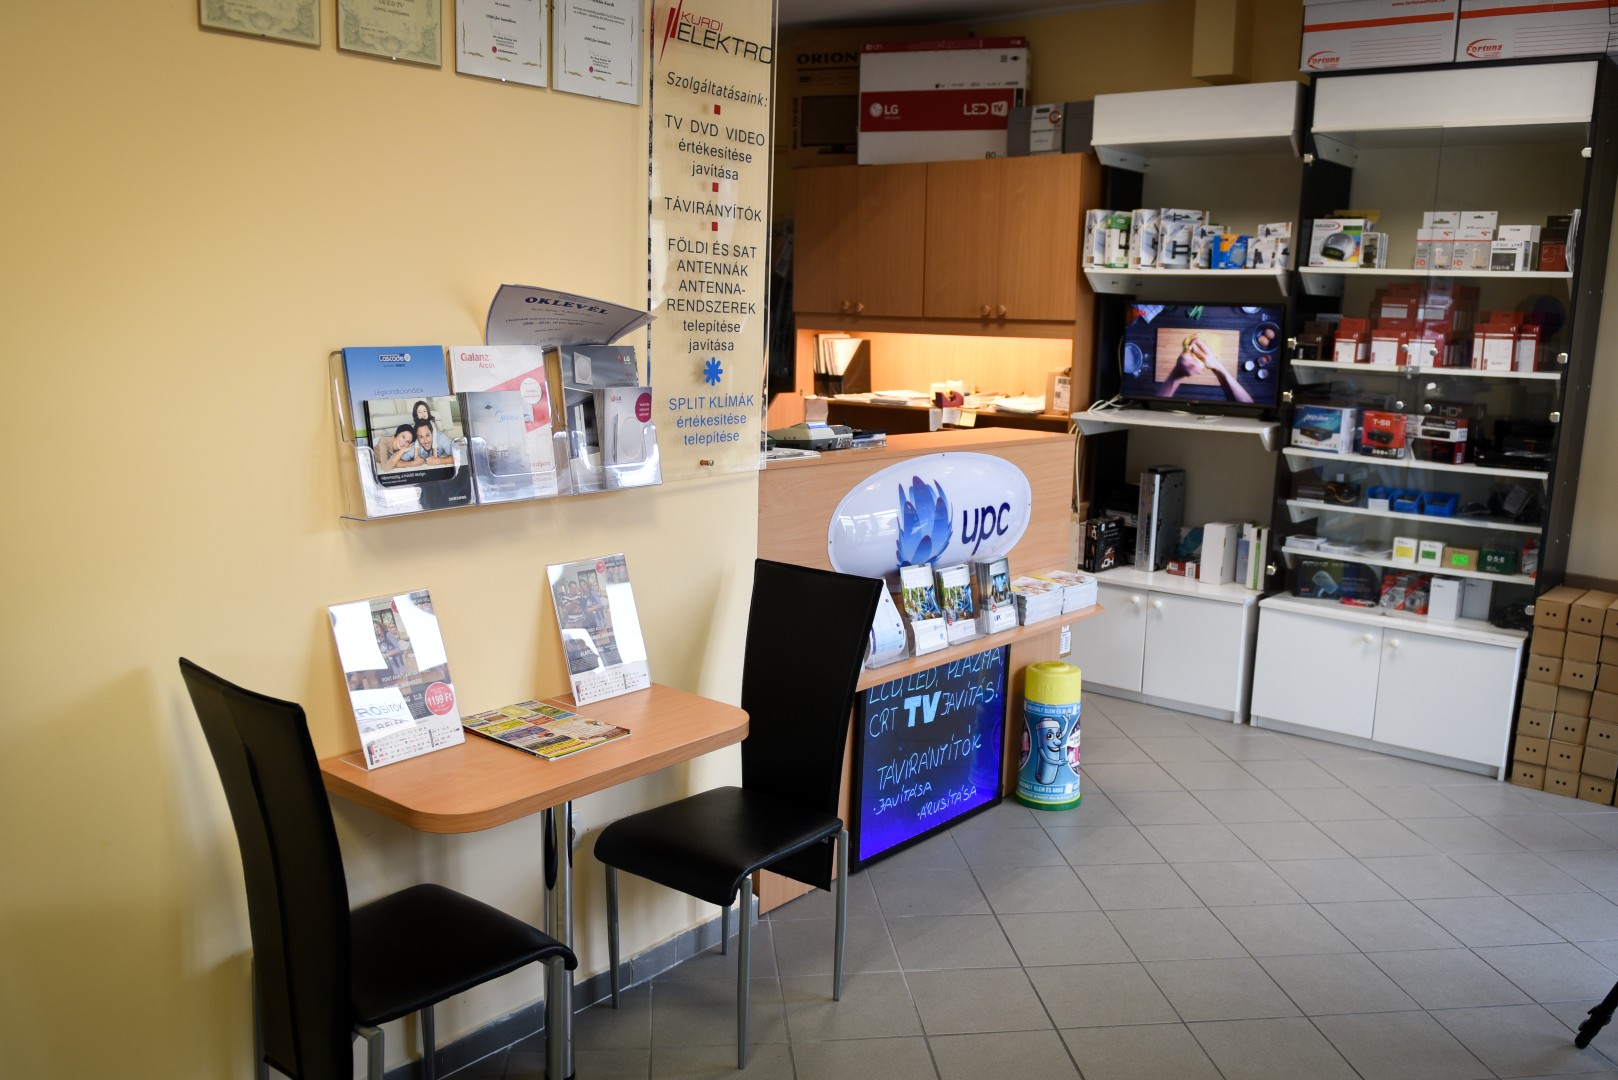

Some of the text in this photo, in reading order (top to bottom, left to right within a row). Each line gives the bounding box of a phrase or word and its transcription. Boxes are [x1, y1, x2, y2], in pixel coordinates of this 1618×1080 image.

[680, 10, 723, 32] KURDI
[677, 22, 773, 64] ELEKTRO
[796, 52, 857, 66] ORION
[666, 71, 768, 108] Szolgáltatásaink:
[884, 104, 899, 115] LG
[963, 103, 989, 116] LED
[665, 114, 765, 147] TV DVD VIDEO
[678, 138, 752, 163] értékesítése
[692, 161, 739, 180] javítása
[665, 196, 762, 222] TÁVIRÁNYÍTÓK
[668, 237, 757, 259] FÖLDI ÉS SAT
[677, 259, 748, 277] ANTENNÁK
[678, 279, 746, 295] ANTENNA-
[524, 296, 609, 315] OKLEVÉL
[667, 298, 756, 315] RENDSZEREK
[683, 319, 741, 334] telepítése
[688, 339, 735, 354] javítása
[460, 352, 489, 362] Galanz
[668, 396, 705, 411] SPLIT
[709, 392, 754, 409] KLÍMÁK
[676, 413, 747, 429] értékesítése
[684, 431, 740, 447] telepítése
[961, 502, 1011, 556] upc
[427, 694, 444, 707] 1199
[869, 706, 899, 738] CRT
[903, 690, 942, 728] TV
